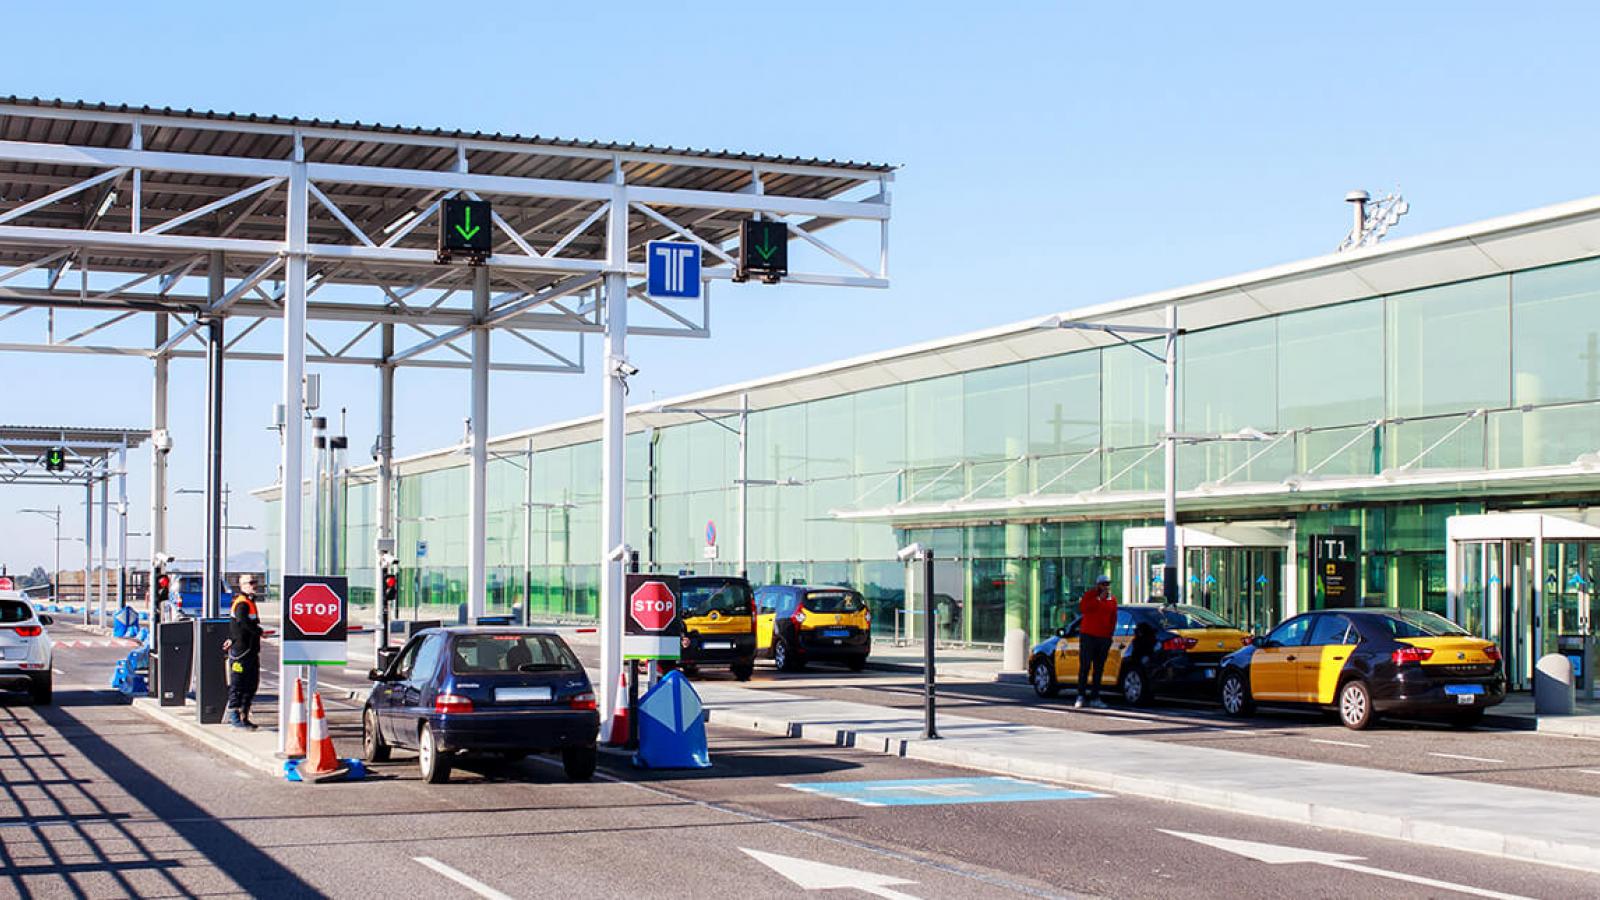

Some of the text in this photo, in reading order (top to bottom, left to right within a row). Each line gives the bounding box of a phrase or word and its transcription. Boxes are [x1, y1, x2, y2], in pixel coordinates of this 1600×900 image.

[1324, 539, 1347, 559] T1
[294, 603, 338, 615] STOP
[635, 600, 673, 612] STOP
